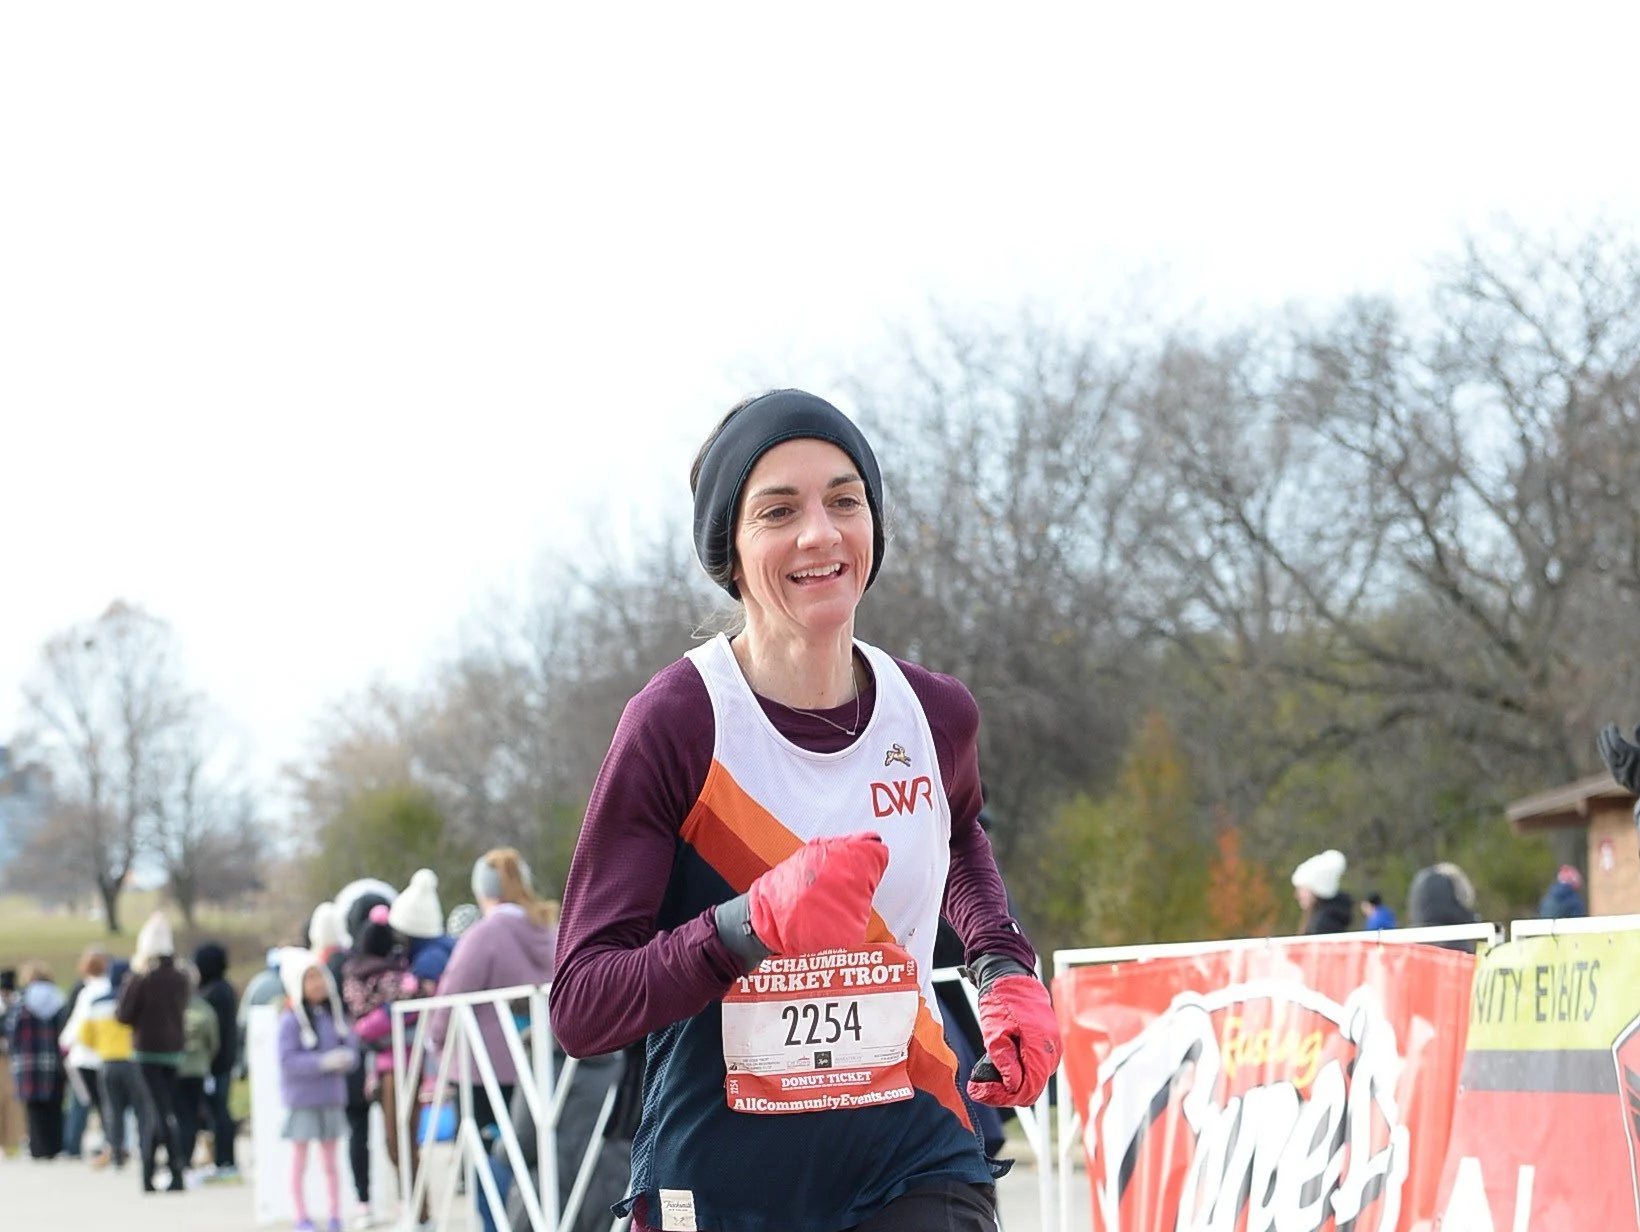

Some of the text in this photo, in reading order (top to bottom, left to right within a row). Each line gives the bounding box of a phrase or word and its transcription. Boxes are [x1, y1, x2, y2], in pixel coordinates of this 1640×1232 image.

[870, 776, 933, 817] DWR
[758, 951, 884, 974] SCHAUMBURG
[906, 960, 915, 977] 2254
[736, 964, 905, 993] TURKEY TROT
[781, 1001, 862, 1046] 2254
[729, 1079, 739, 1095] 2254
[781, 1071, 872, 1088] DONUT TICKET
[733, 1087, 912, 1112] AllCommunityEvents.com
